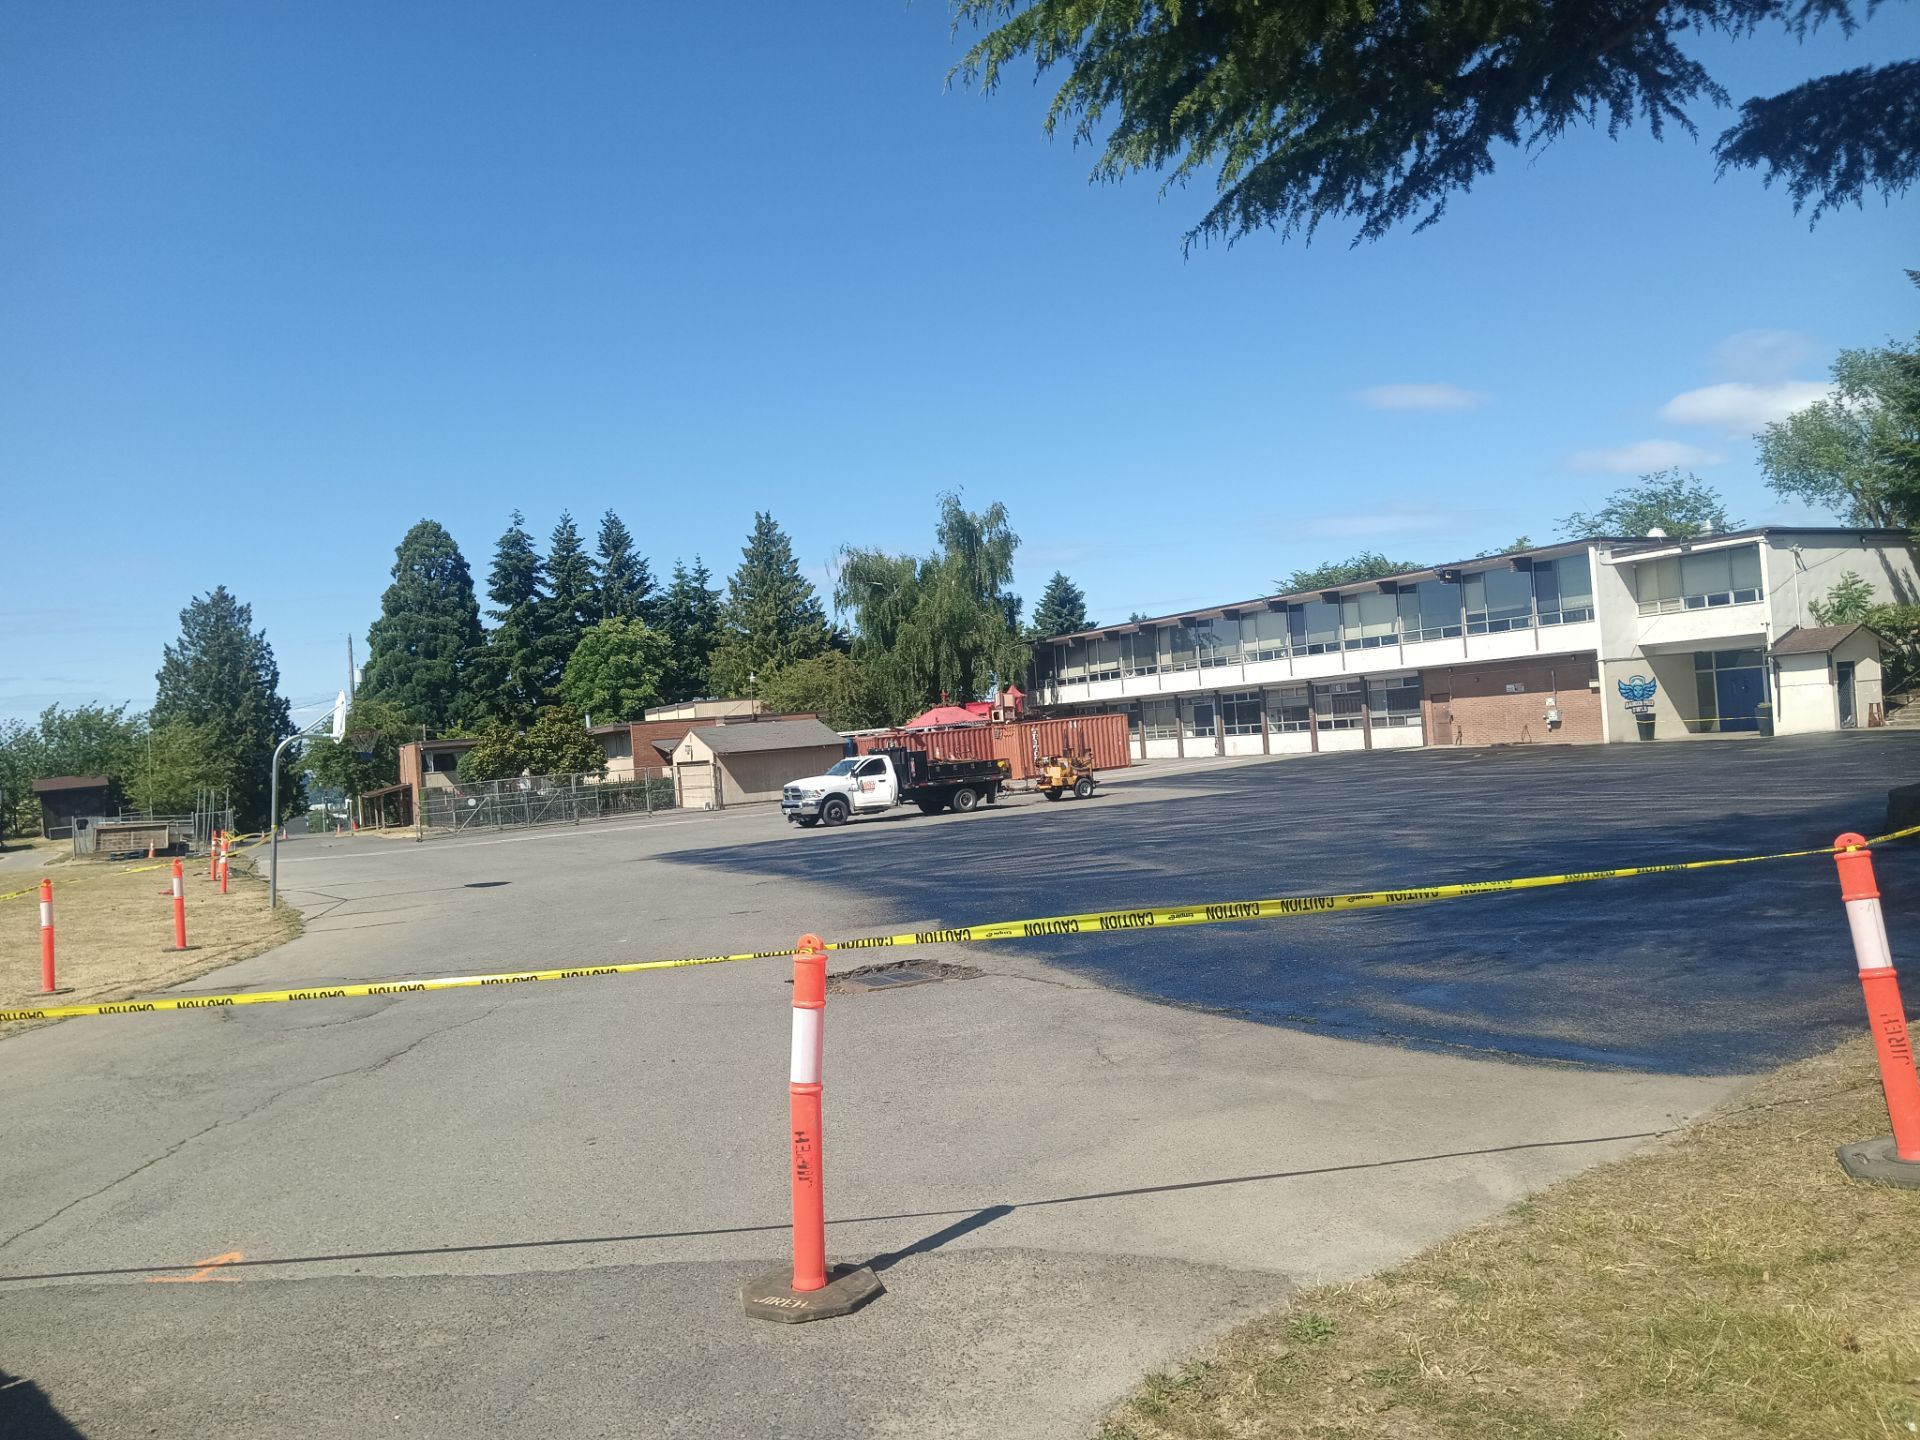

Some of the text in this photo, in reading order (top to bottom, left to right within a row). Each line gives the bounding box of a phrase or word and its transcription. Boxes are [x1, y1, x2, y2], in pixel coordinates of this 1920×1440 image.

[1206, 903, 1260, 920] CAUTION
[1280, 897, 1334, 913] CAUTION
[1023, 919, 1079, 935] CAUTION
[1099, 912, 1155, 930] CAUTION
[915, 928, 971, 945] CAUTION
[752, 1296, 809, 1309] JIREH
